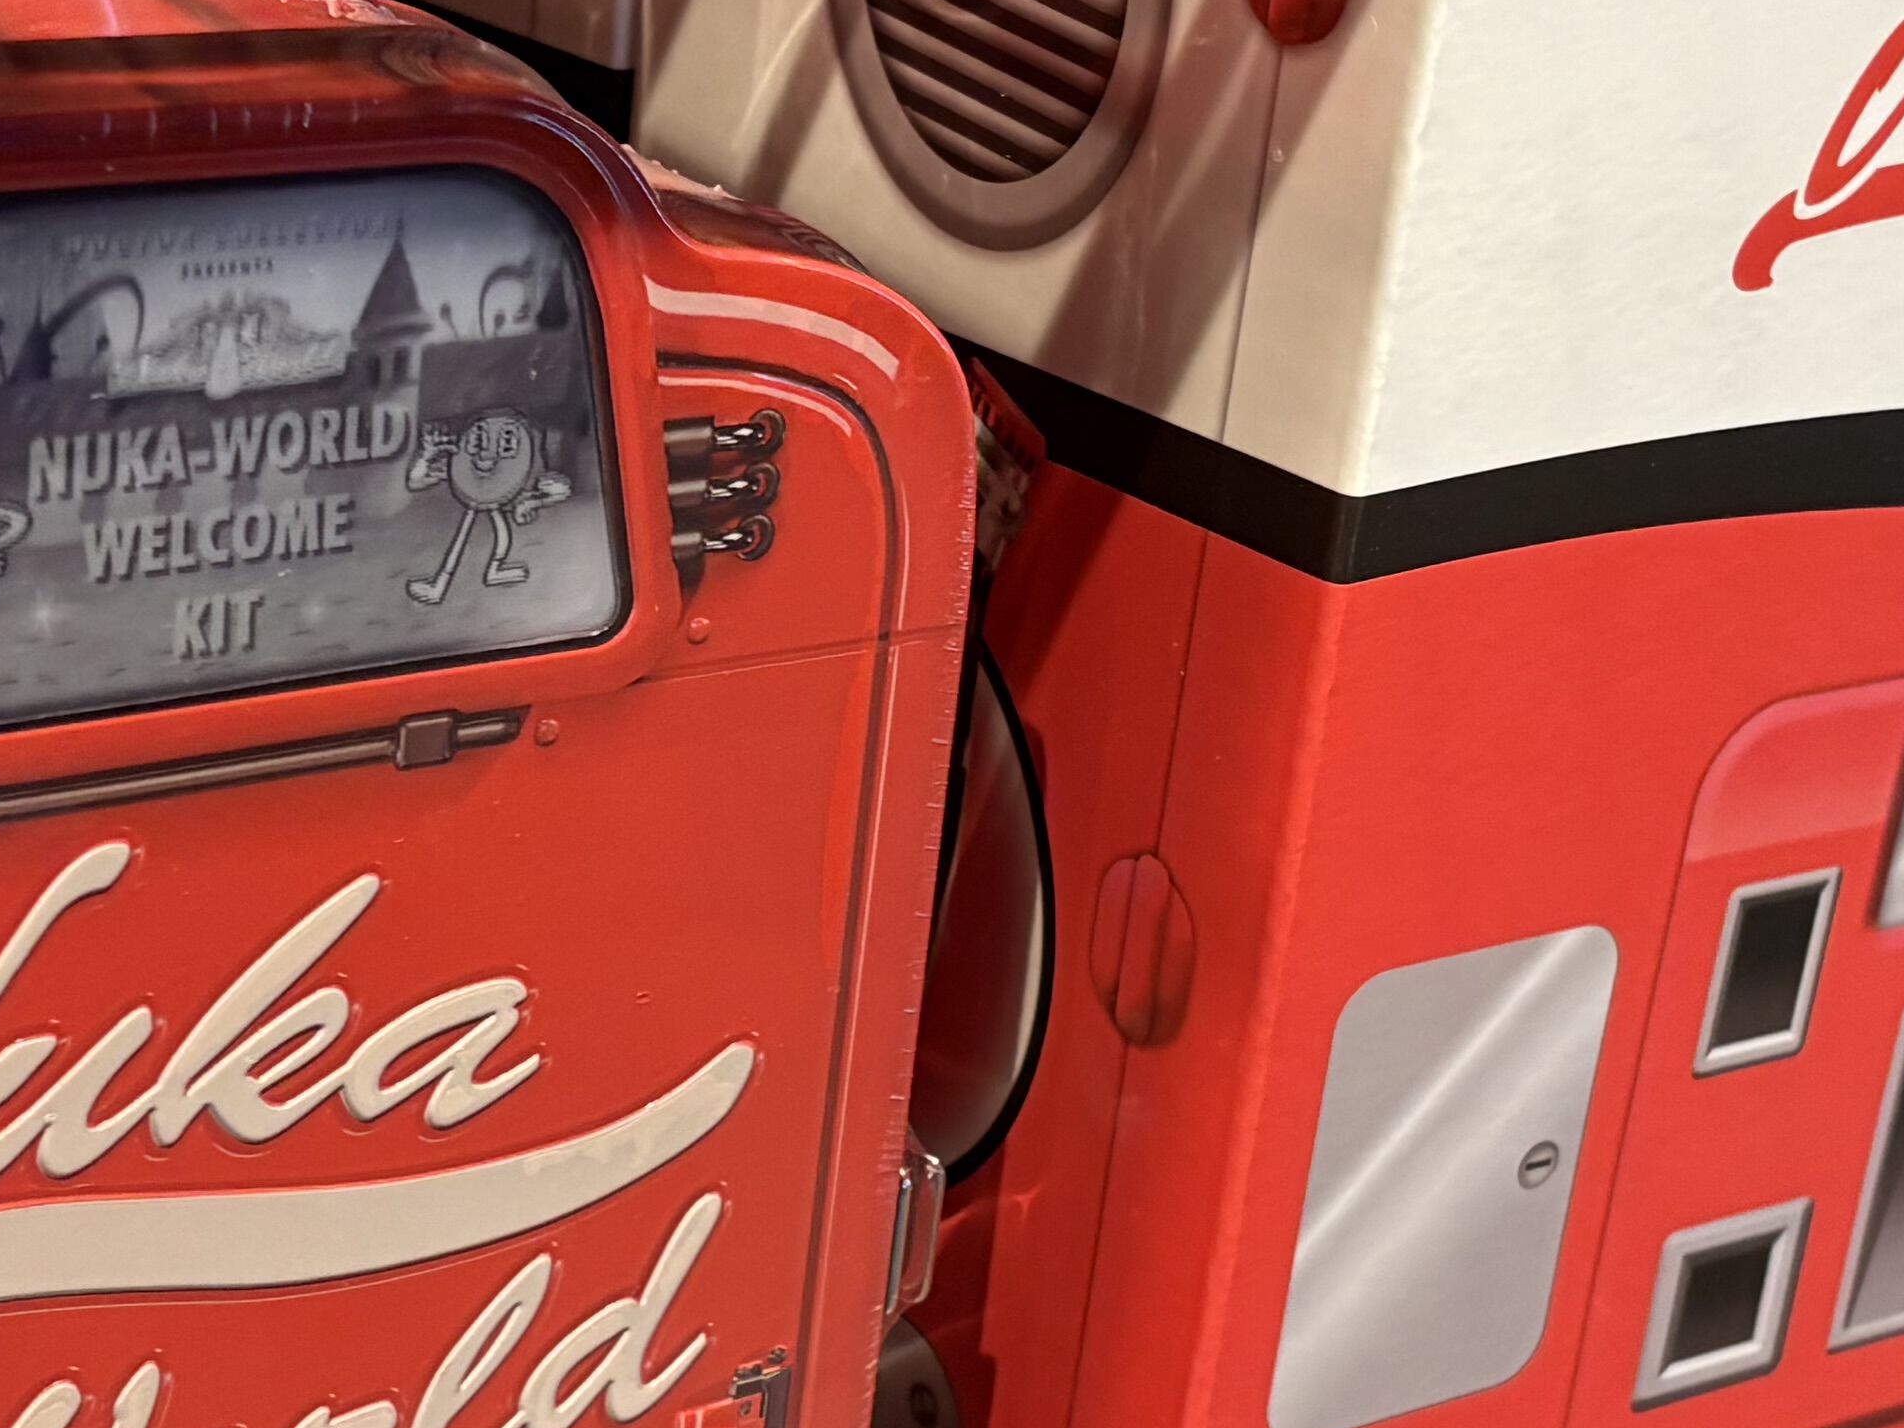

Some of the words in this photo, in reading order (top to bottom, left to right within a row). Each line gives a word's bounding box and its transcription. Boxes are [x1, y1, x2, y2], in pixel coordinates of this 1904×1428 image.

[28, 401, 409, 503] NUKA-WORLD
[84, 493, 354, 584] WELCOME
[173, 589, 265, 661] KIT
